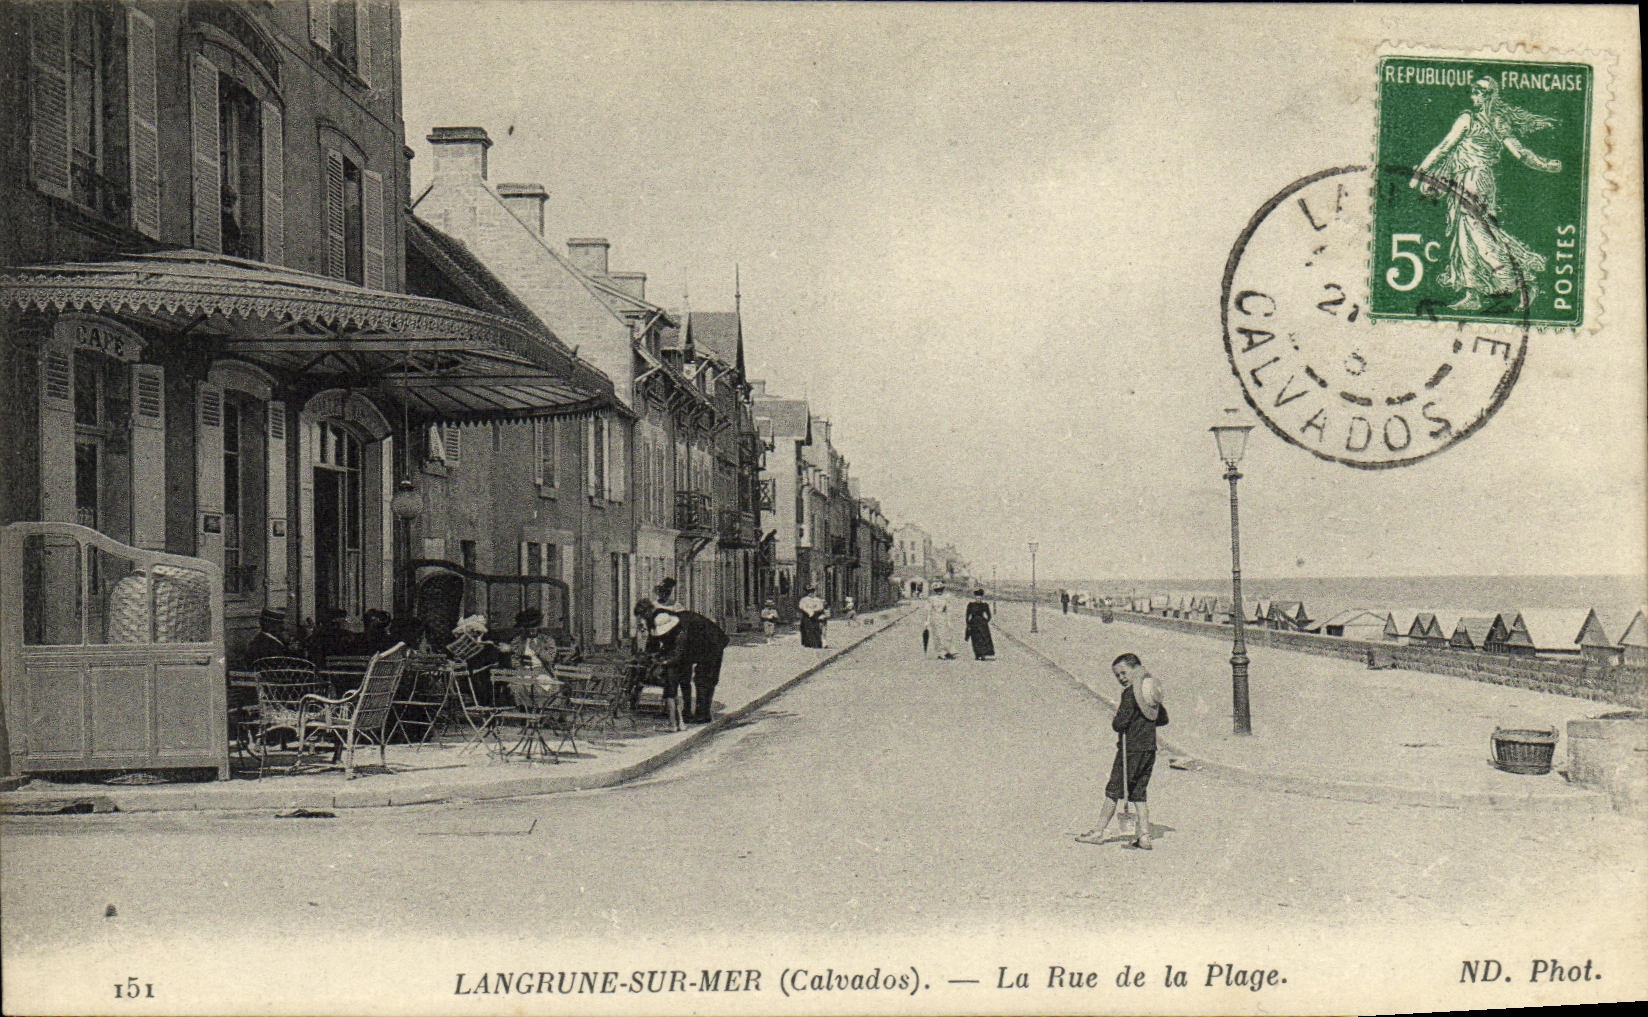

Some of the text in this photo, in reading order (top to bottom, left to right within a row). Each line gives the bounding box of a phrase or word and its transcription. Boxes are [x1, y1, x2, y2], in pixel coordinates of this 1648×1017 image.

[1500, 71, 1583, 92] FRANÇAISE
[1553, 224, 1576, 310] POSTES
[1234, 289, 1453, 452] CALVADOS
